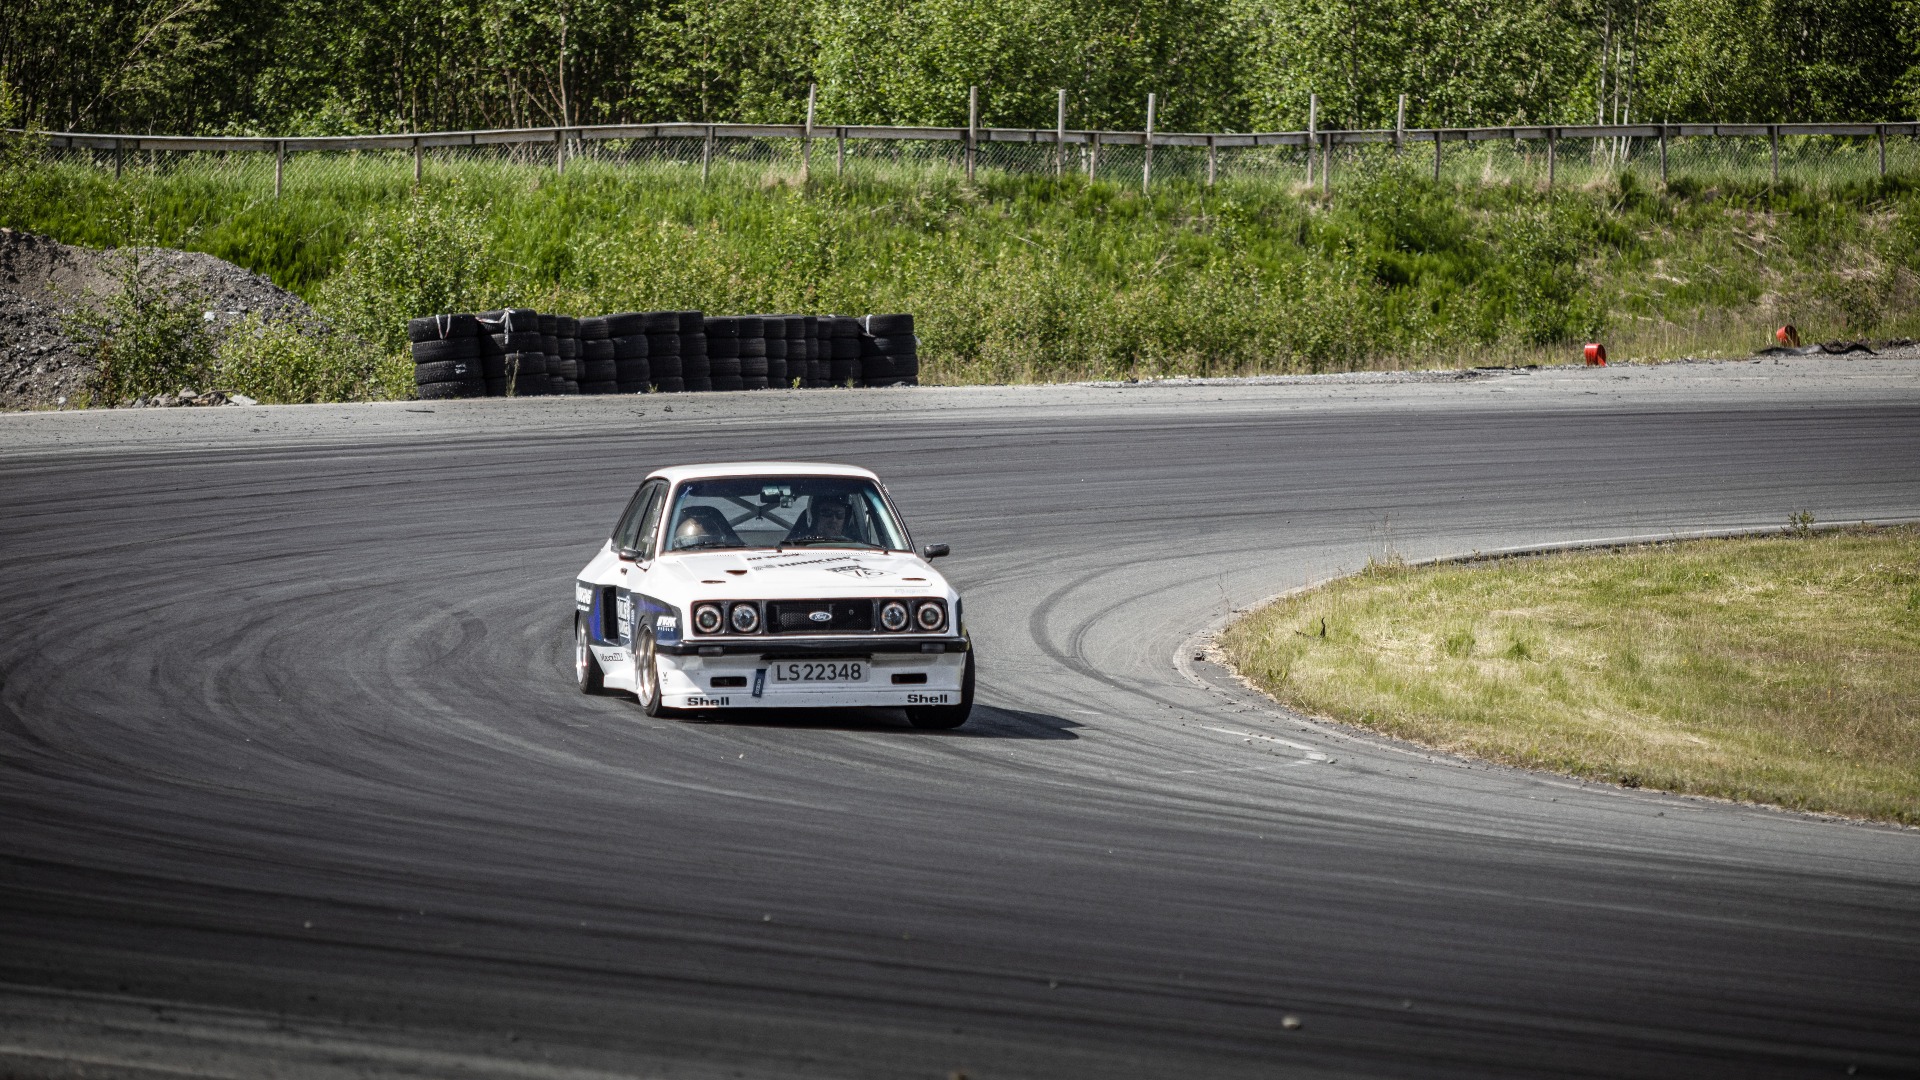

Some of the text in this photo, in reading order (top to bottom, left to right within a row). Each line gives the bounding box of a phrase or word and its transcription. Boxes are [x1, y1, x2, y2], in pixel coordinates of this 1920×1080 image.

[777, 663, 862, 681] LS22348
[687, 697, 730, 706] Shell
[907, 694, 948, 704] Shell
